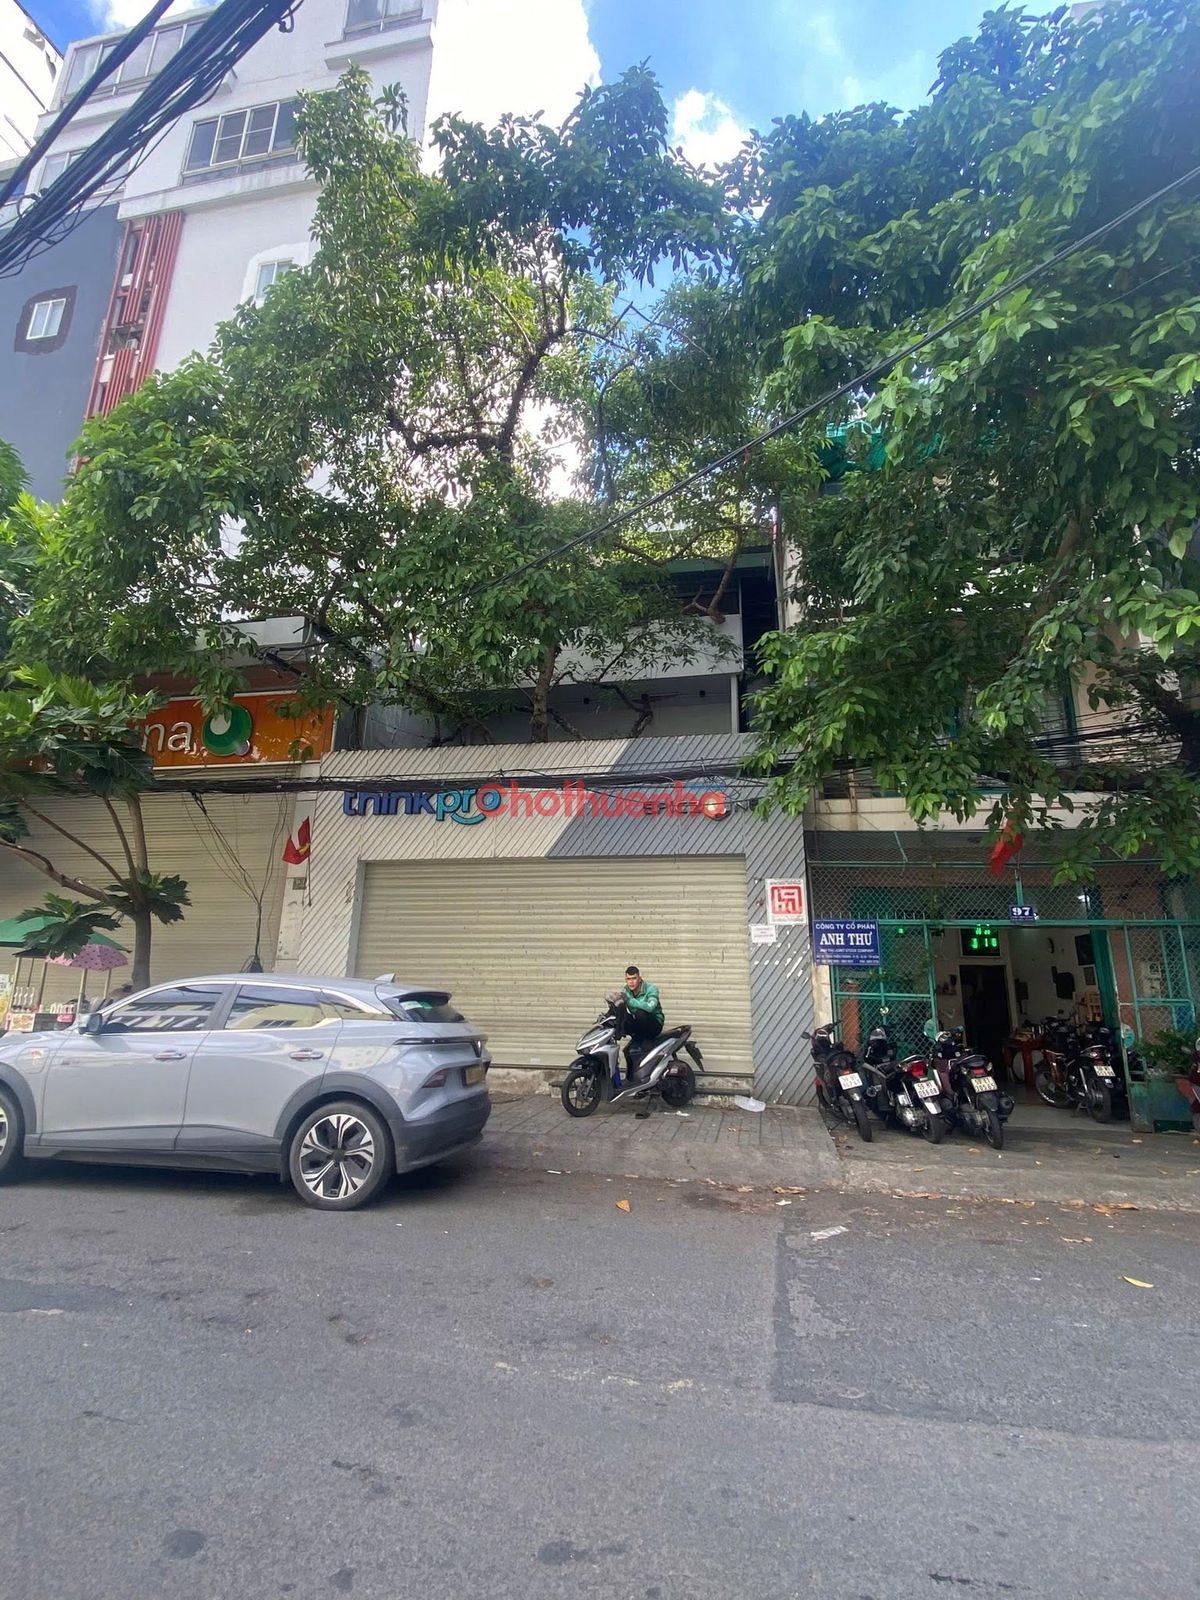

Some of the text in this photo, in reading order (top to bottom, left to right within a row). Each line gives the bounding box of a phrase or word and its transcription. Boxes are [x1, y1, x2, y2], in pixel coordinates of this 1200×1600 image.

[1012, 907, 1031, 916] 97
[820, 931, 873, 946] ANH THƯ
